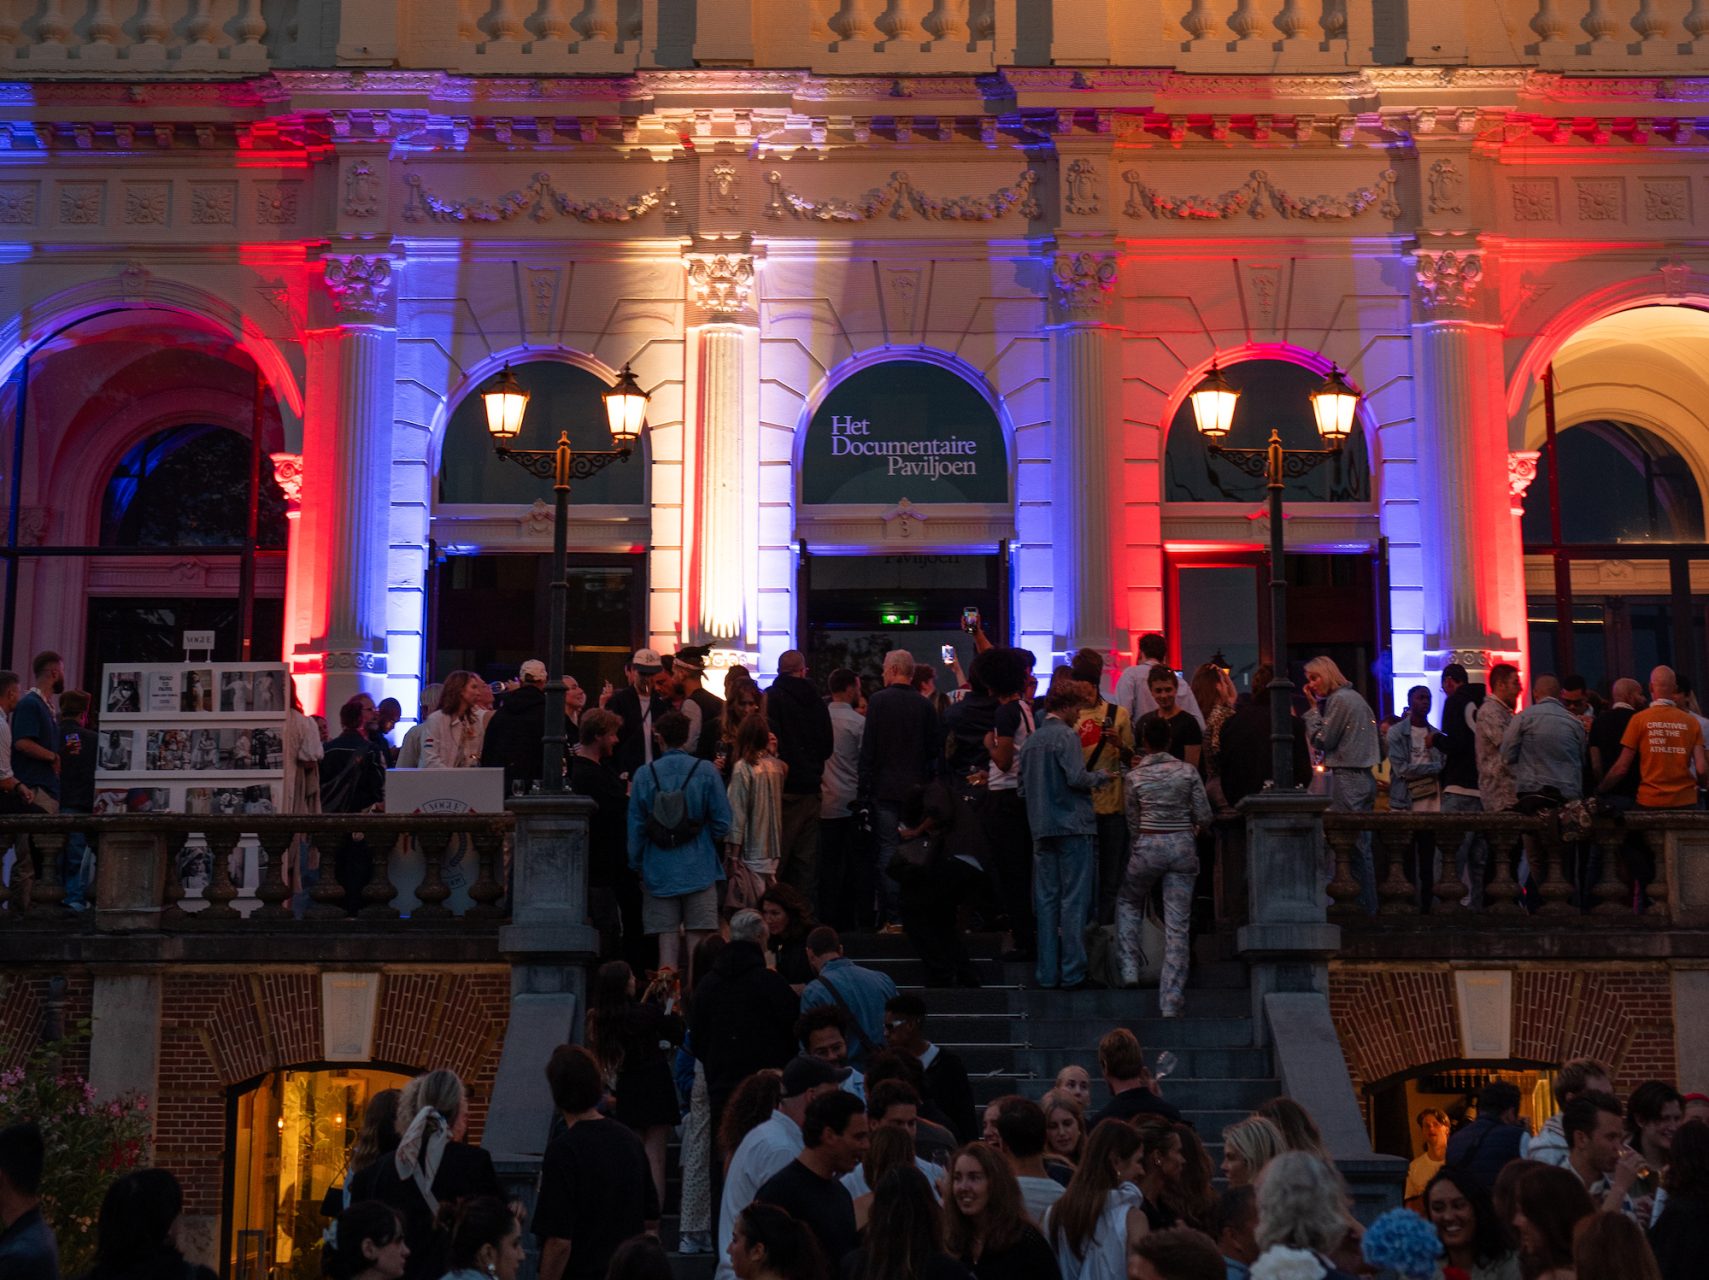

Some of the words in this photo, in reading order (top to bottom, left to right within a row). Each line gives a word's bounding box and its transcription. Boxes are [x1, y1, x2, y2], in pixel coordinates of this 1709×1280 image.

[831, 415, 871, 436] Het
[831, 435, 977, 456] Documentaire
[887, 455, 977, 481] Paviljoen
[1647, 721, 1688, 730] CREATIVES
[1648, 729, 1665, 737] ARE
[1665, 730, 1681, 738] THE
[1649, 737, 1667, 745] NEW
[1650, 746, 1687, 754] ATHLETES
